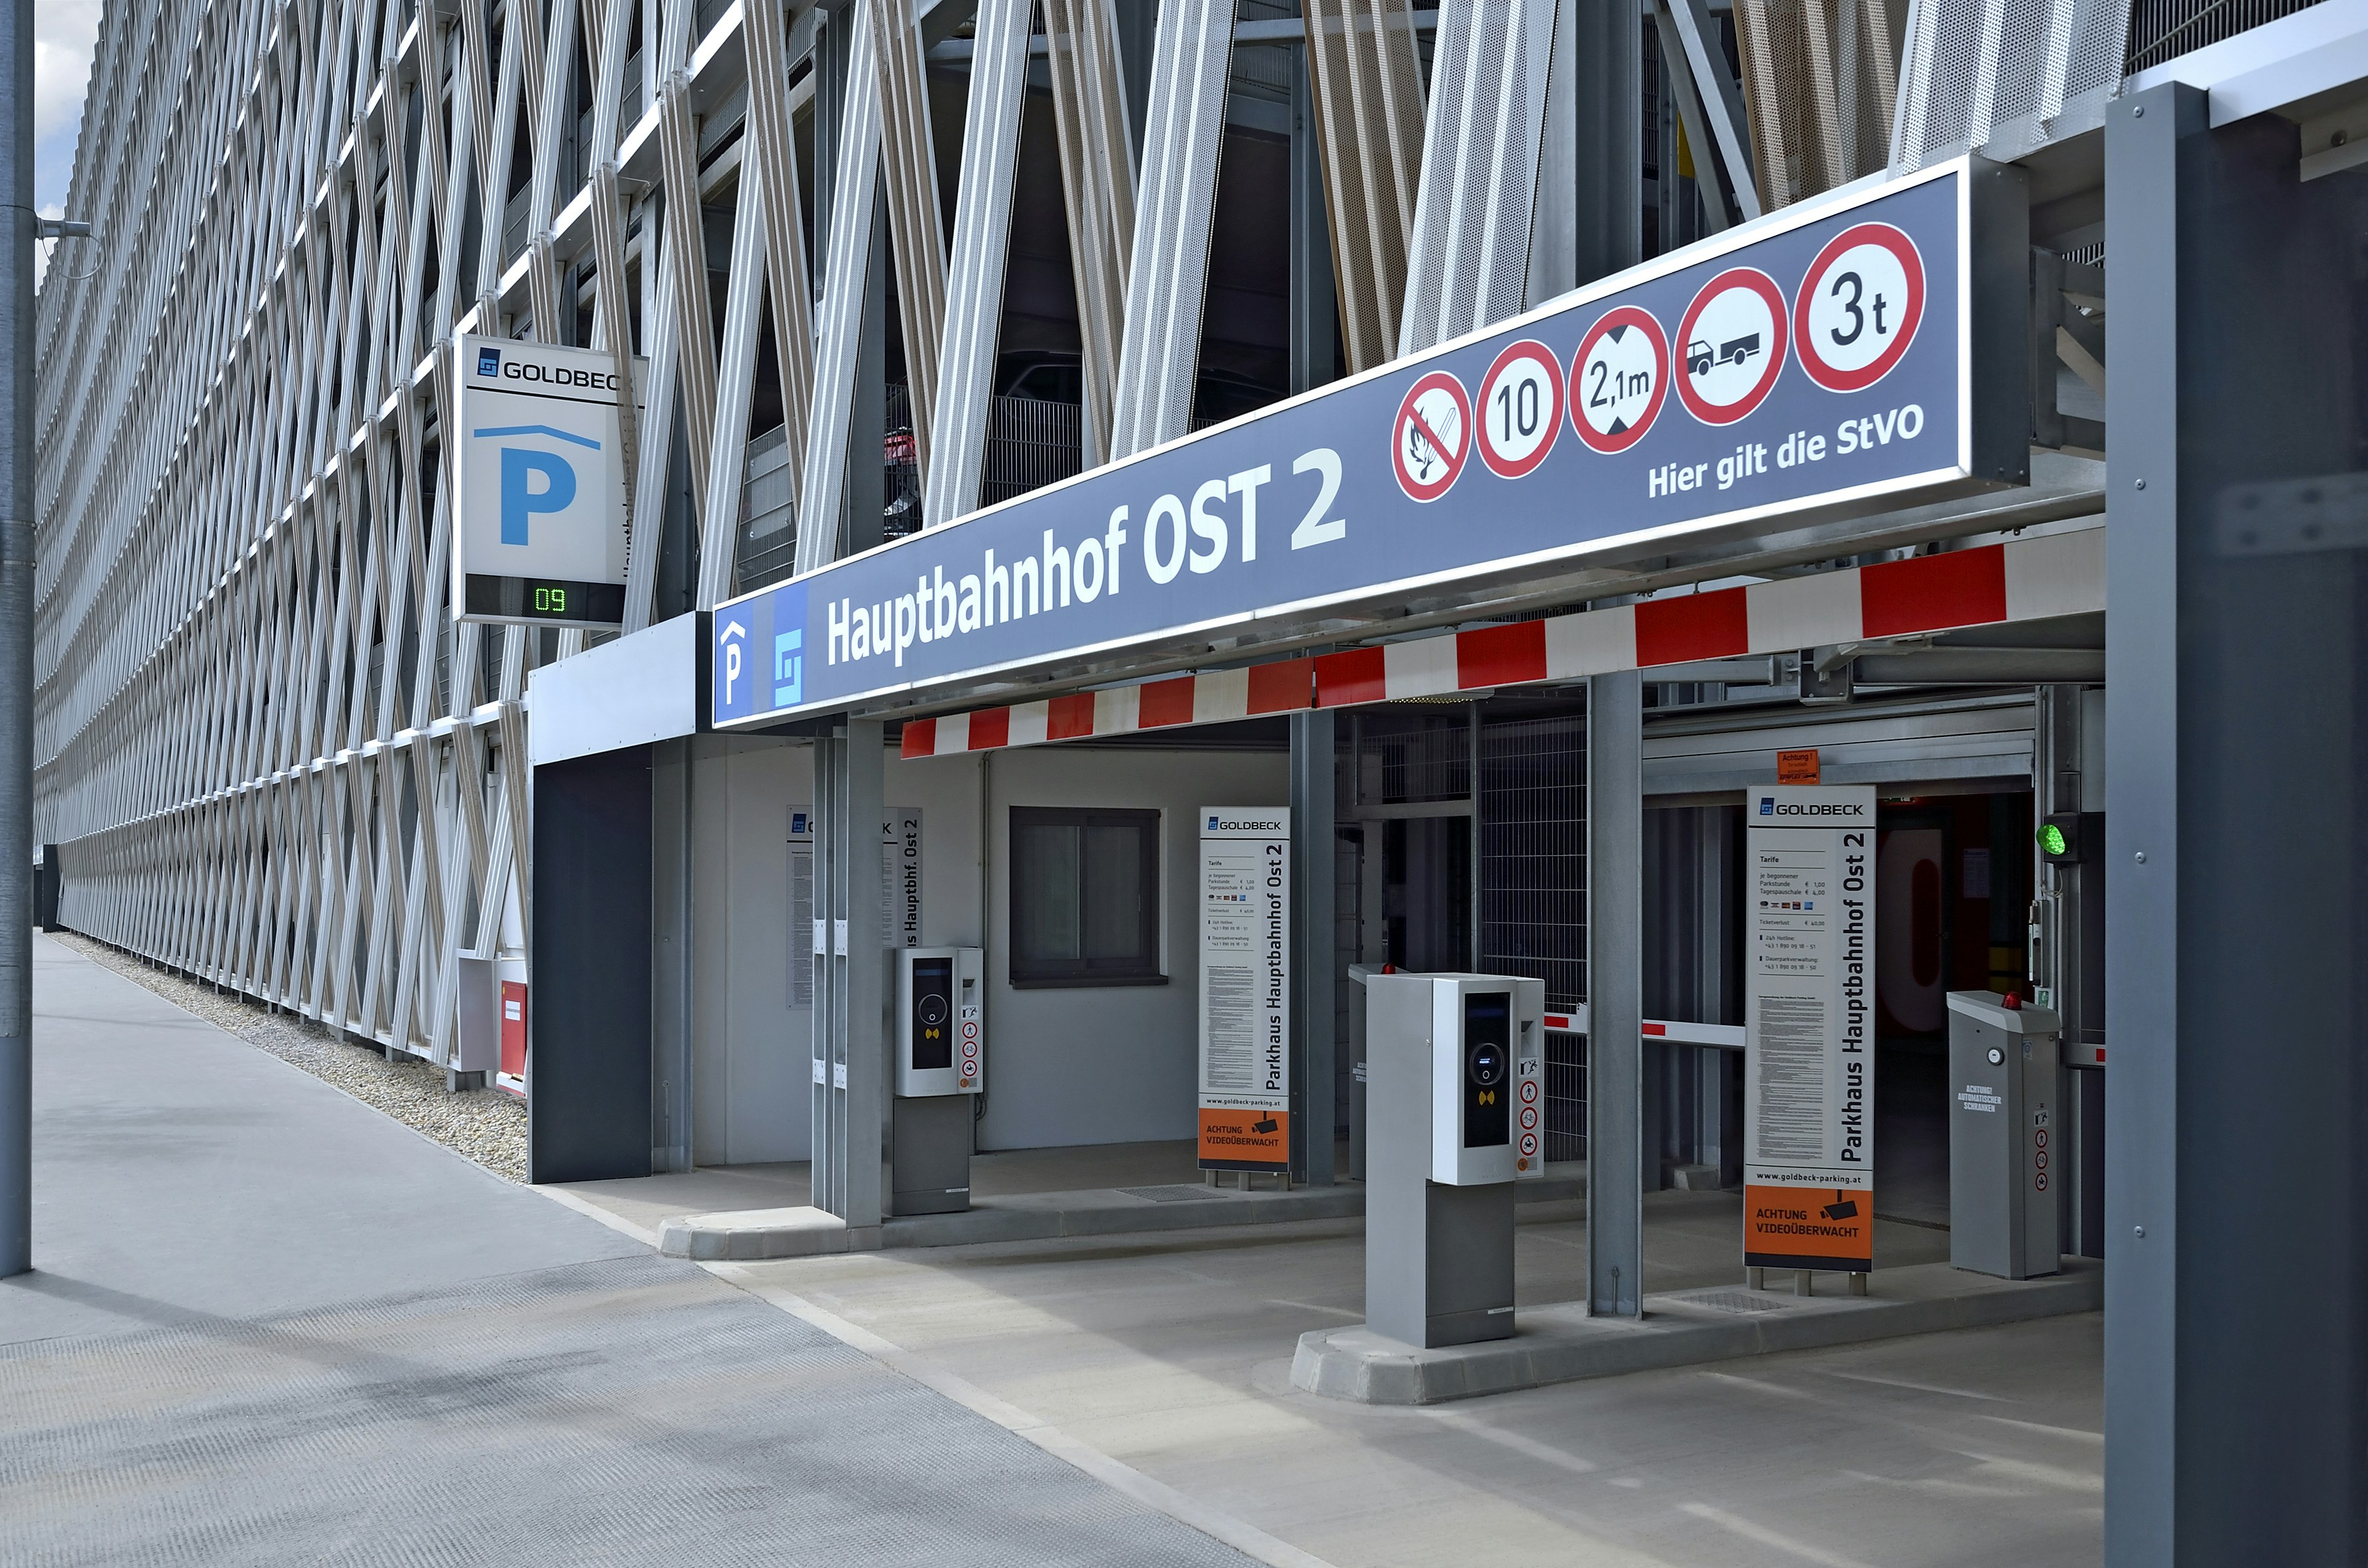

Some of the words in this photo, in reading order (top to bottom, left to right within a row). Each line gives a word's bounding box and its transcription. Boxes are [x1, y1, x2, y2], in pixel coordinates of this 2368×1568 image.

[503, 362, 640, 393] GOLDBEC
[1589, 360, 1649, 410] 2,1m
[1498, 377, 1538, 442] 10
[1648, 464, 1707, 498] Hier
[1717, 448, 1769, 490] gilt
[1777, 435, 1826, 467] die
[1837, 404, 1924, 455] StVO
[501, 447, 576, 546] P
[829, 505, 1129, 668] Hauptbahnhof
[1143, 464, 1271, 584] OST
[1291, 448, 1346, 552] 2
[535, 588, 565, 611] 09
[726, 639, 741, 705] P
[1776, 805, 1863, 815] GOLDBECK
[904, 834, 917, 857] Ost
[1267, 845, 1281, 854] 2
[1843, 833, 1864, 847] 2
[1267, 860, 1281, 888] Ost
[1844, 855, 1863, 891] Ost
[904, 862, 919, 931] Hauptbhf.
[1267, 894, 1285, 1008] Hauptbahnhof
[1842, 900, 1867, 1053] Hauptbahnhof
[1266, 1015, 1281, 1090] Parkhaus
[1842, 1062, 1862, 1162] Parkhaus
[1958, 1093, 2002, 1104] AUTOMATISCHER
[1964, 1102, 1995, 1112] SCHRANKEN
[1207, 1136, 1279, 1146] VIDEOÜBERWACHT
[1757, 1172, 1861, 1184] www.goldbeck-parking.at
[1757, 1208, 1807, 1220] ACHTUNG
[1757, 1223, 1859, 1237] VIDEOÜBERWACHT
